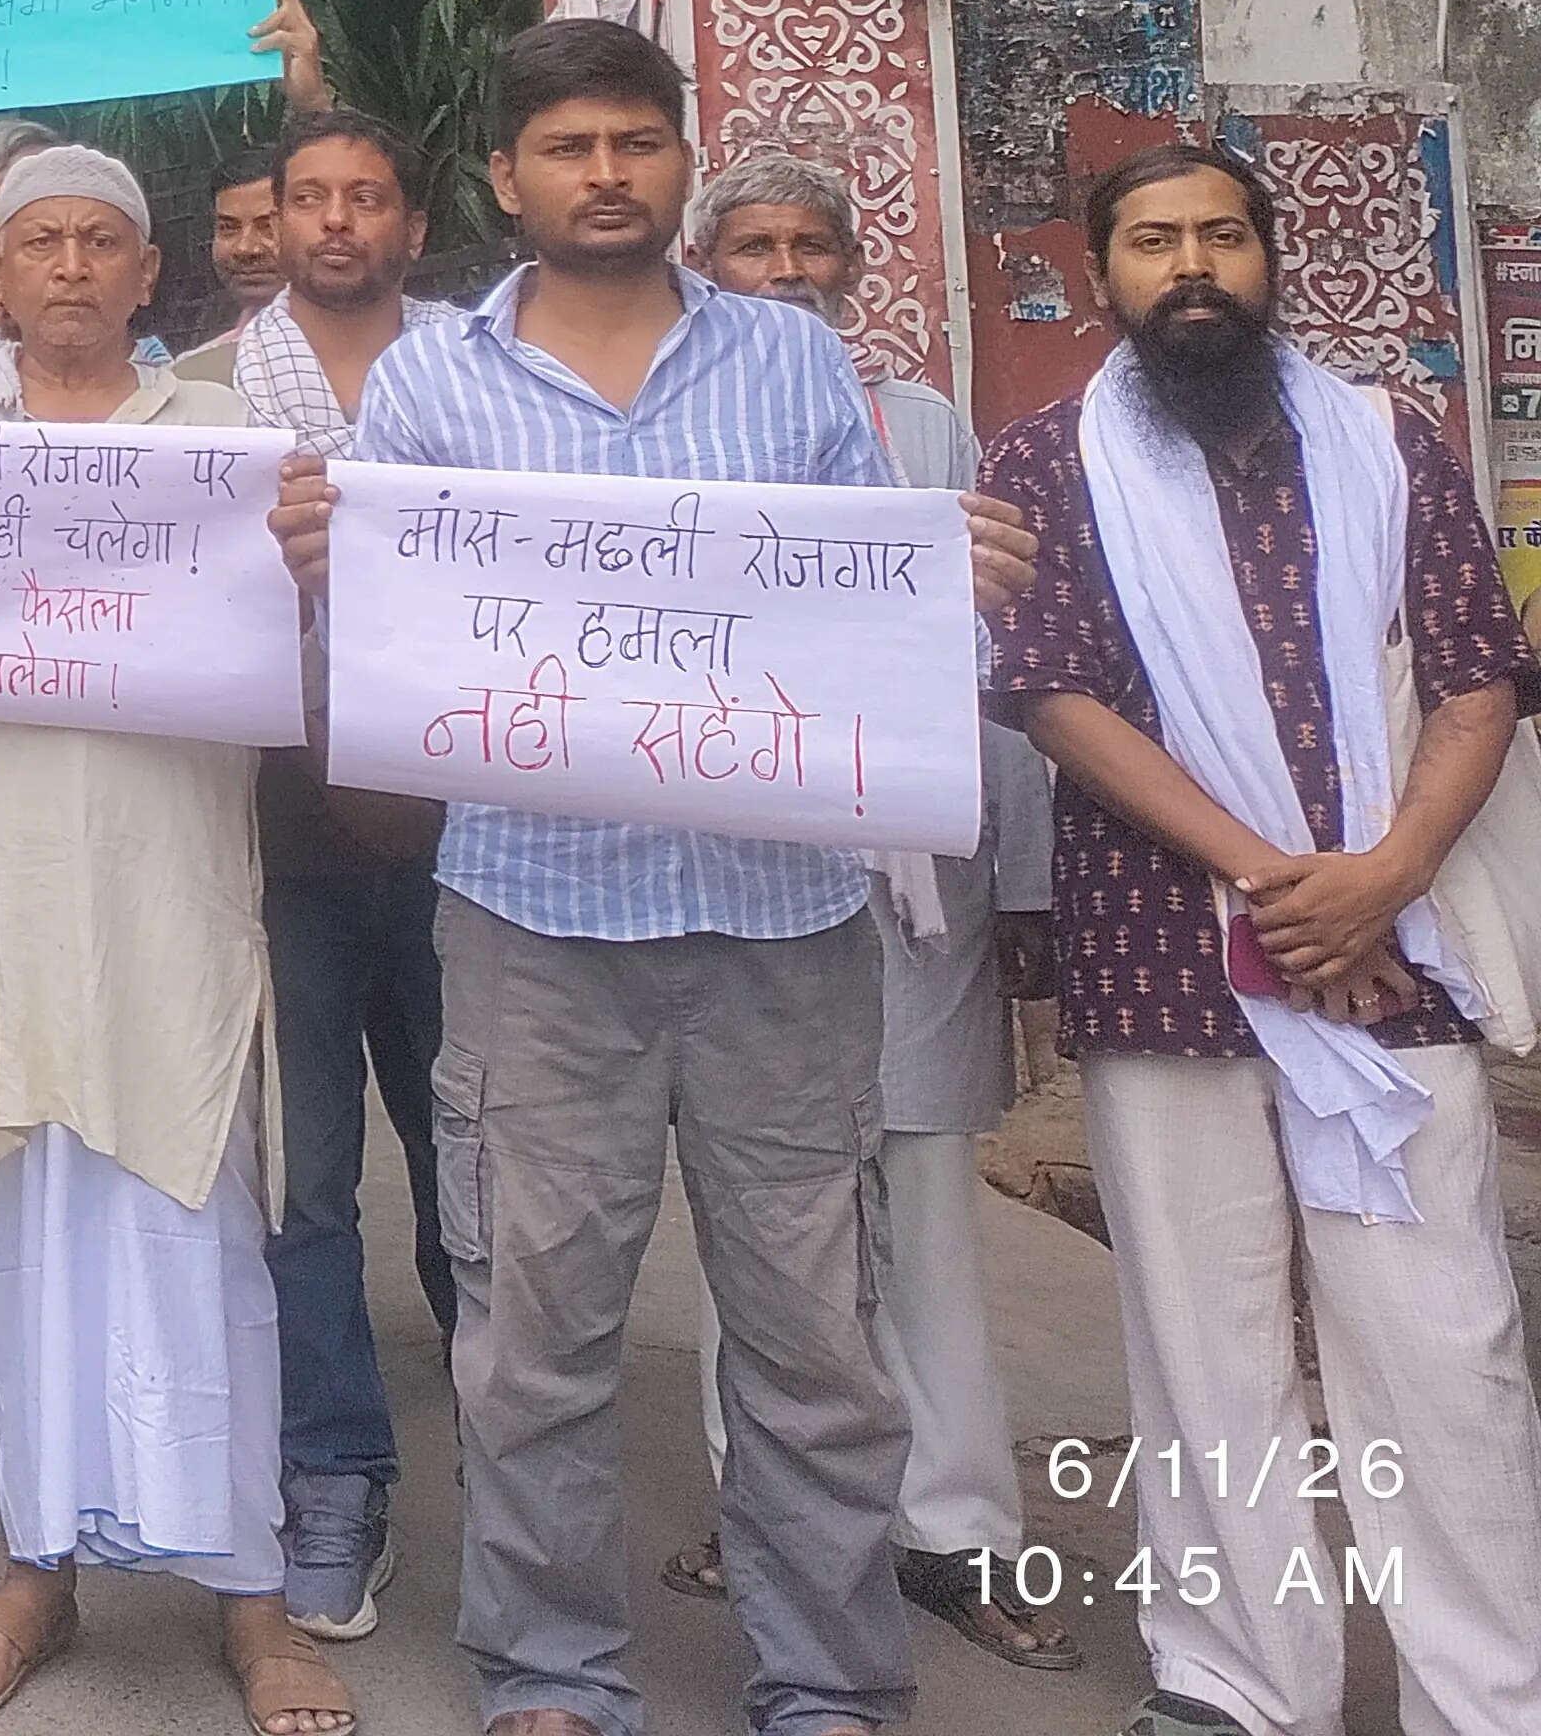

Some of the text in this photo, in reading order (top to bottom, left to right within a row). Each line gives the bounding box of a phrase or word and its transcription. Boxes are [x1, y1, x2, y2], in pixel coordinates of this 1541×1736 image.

[19, 428, 154, 490] रोजगार
[184, 450, 248, 500] पर
[739, 510, 934, 598] रोजगार
[12, 567, 151, 634] फैसला
[463, 594, 754, 675] पर हमला
[621, 670, 821, 788] सहेंगे
